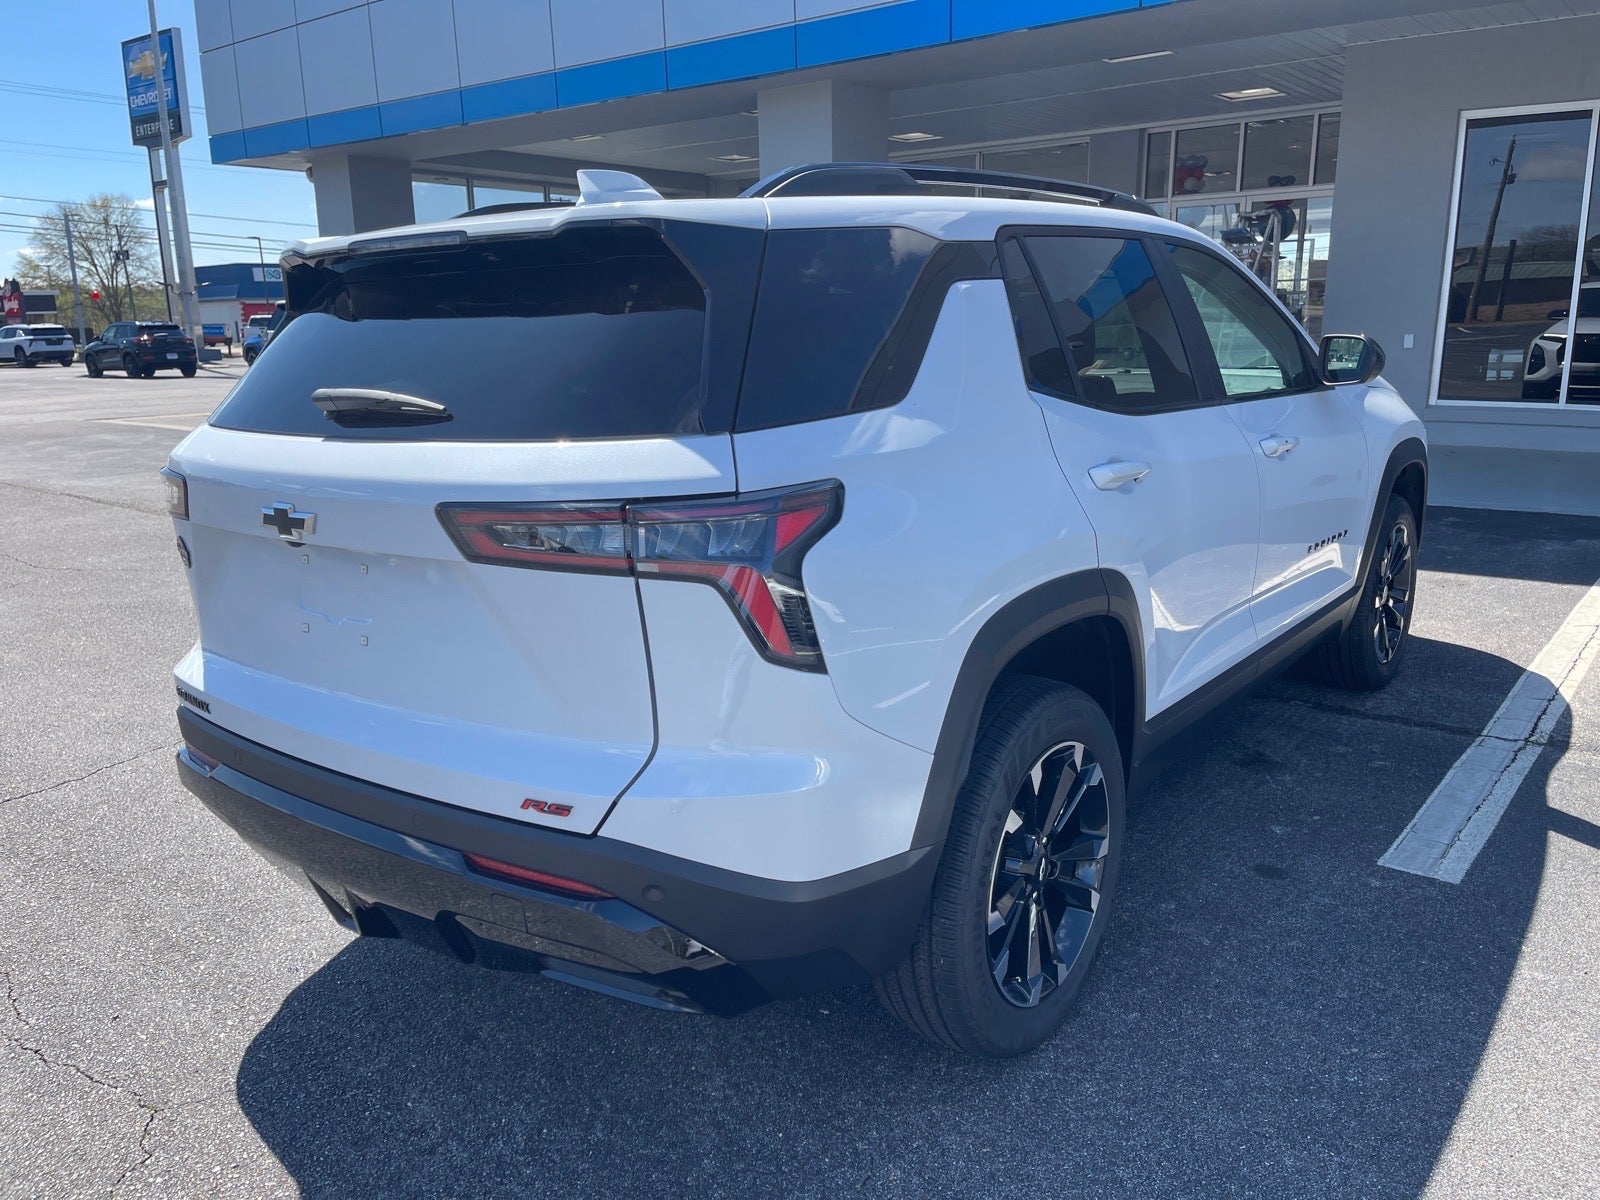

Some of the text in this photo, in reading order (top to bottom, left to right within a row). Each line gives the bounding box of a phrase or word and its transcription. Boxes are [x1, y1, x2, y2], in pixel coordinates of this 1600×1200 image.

[130, 87, 172, 107] CHEVROET
[136, 119, 175, 136] ENTERPE
[520, 798, 574, 817] RS
